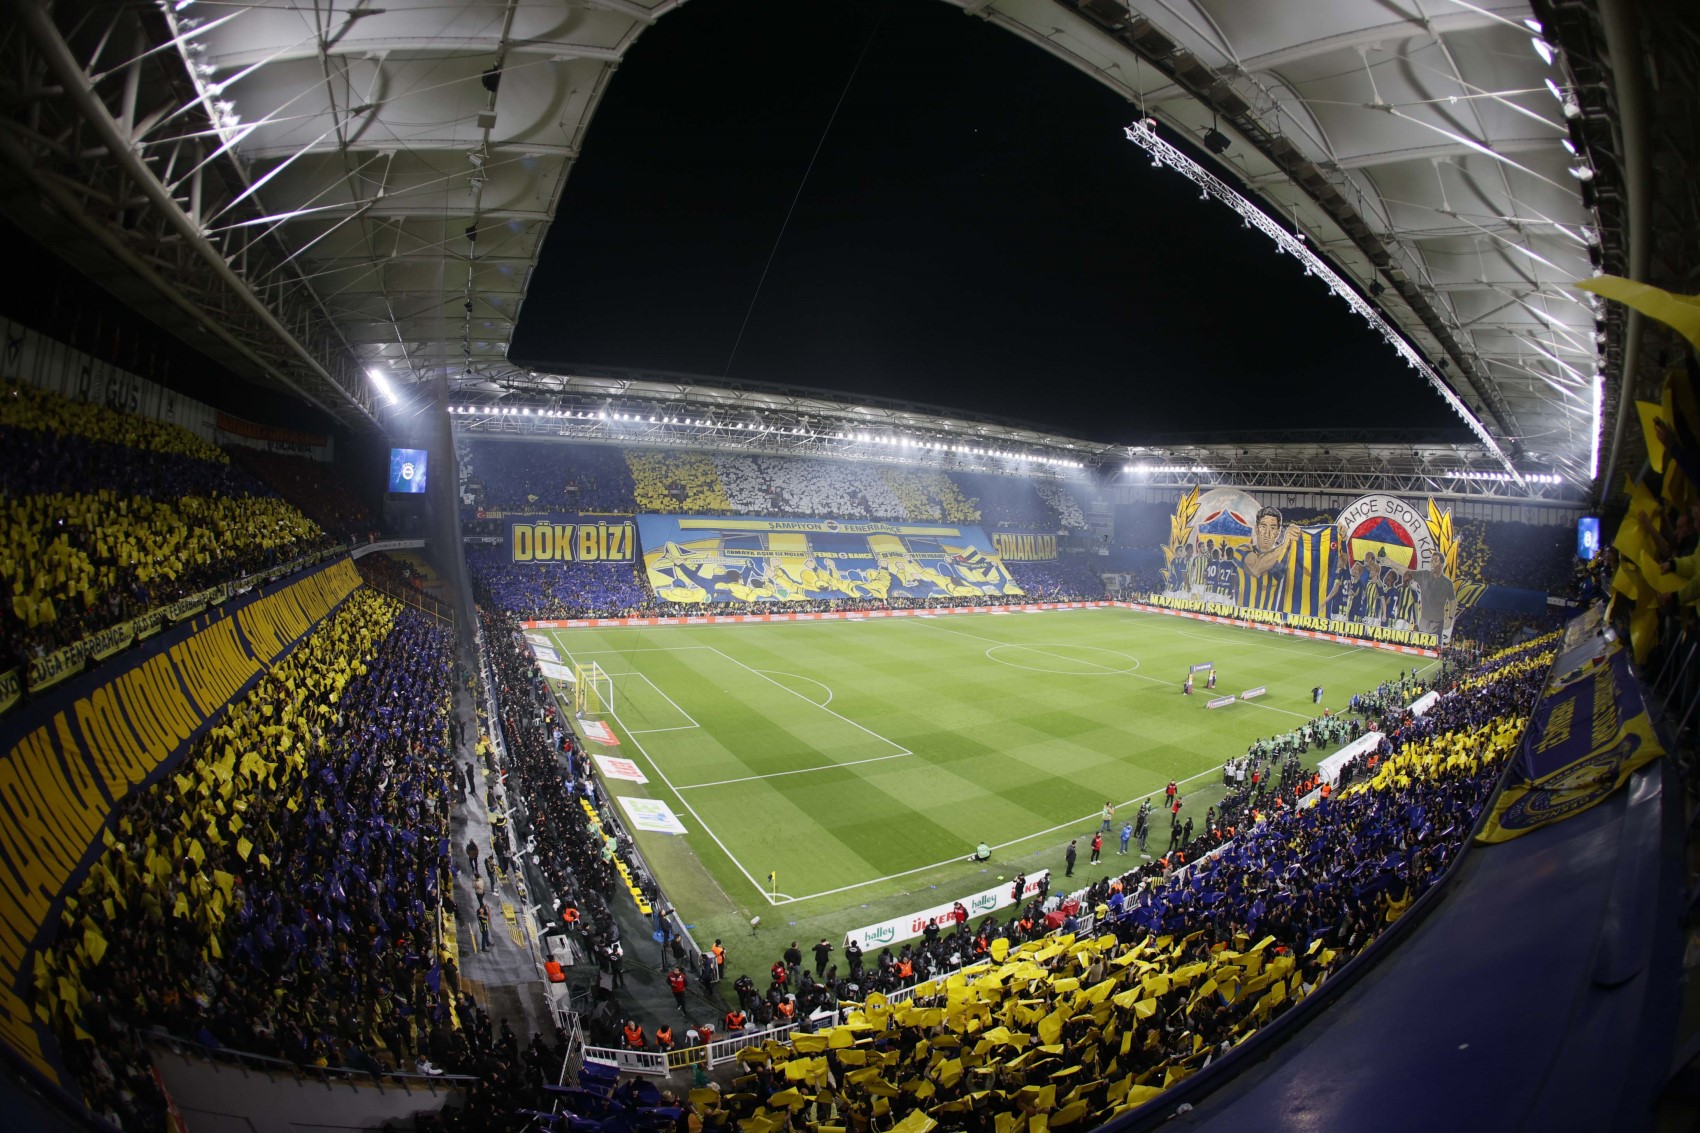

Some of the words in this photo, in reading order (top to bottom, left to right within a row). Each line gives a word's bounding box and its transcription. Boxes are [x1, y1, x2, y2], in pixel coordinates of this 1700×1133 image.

[1385, 500, 1422, 533] SPOR
[769, 521, 822, 531] ŞAMPİYON
[844, 523, 901, 534] FENERBAHÇE
[513, 522, 574, 561] DÖK
[578, 521, 633, 561] BİZİ
[1206, 565, 1217, 577] 10
[1220, 569, 1231, 581] 27
[73, 652, 204, 802] DOLUDUR
[971, 894, 997, 910] halley
[864, 925, 895, 943] halley
